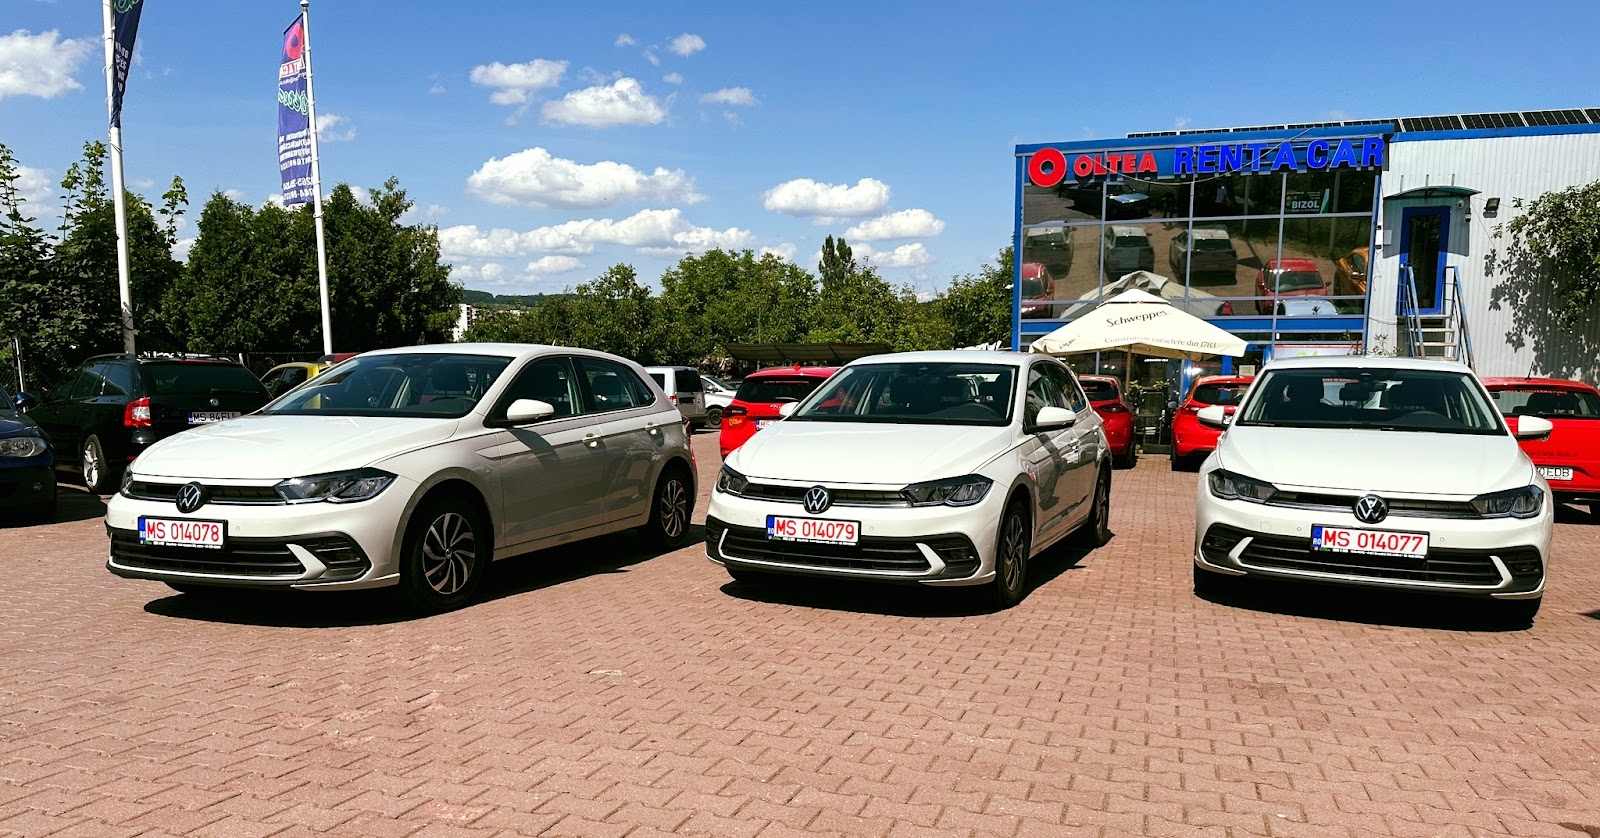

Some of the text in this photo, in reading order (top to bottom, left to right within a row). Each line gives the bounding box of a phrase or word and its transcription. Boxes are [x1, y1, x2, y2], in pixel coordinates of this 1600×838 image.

[1073, 137, 1385, 176] OLTEA RENT A CAR
[1291, 200, 1320, 209] BIZOL
[1106, 309, 1168, 328] Schweppes
[1186, 339, 1199, 348] din
[1200, 341, 1217, 349] 1783
[193, 412, 207, 422] MS
[147, 521, 166, 540] MS
[170, 522, 220, 543] 014078
[776, 519, 797, 536] MS
[802, 520, 855, 541] 014079
[1323, 529, 1351, 548] MS
[1357, 532, 1424, 553] 014077
